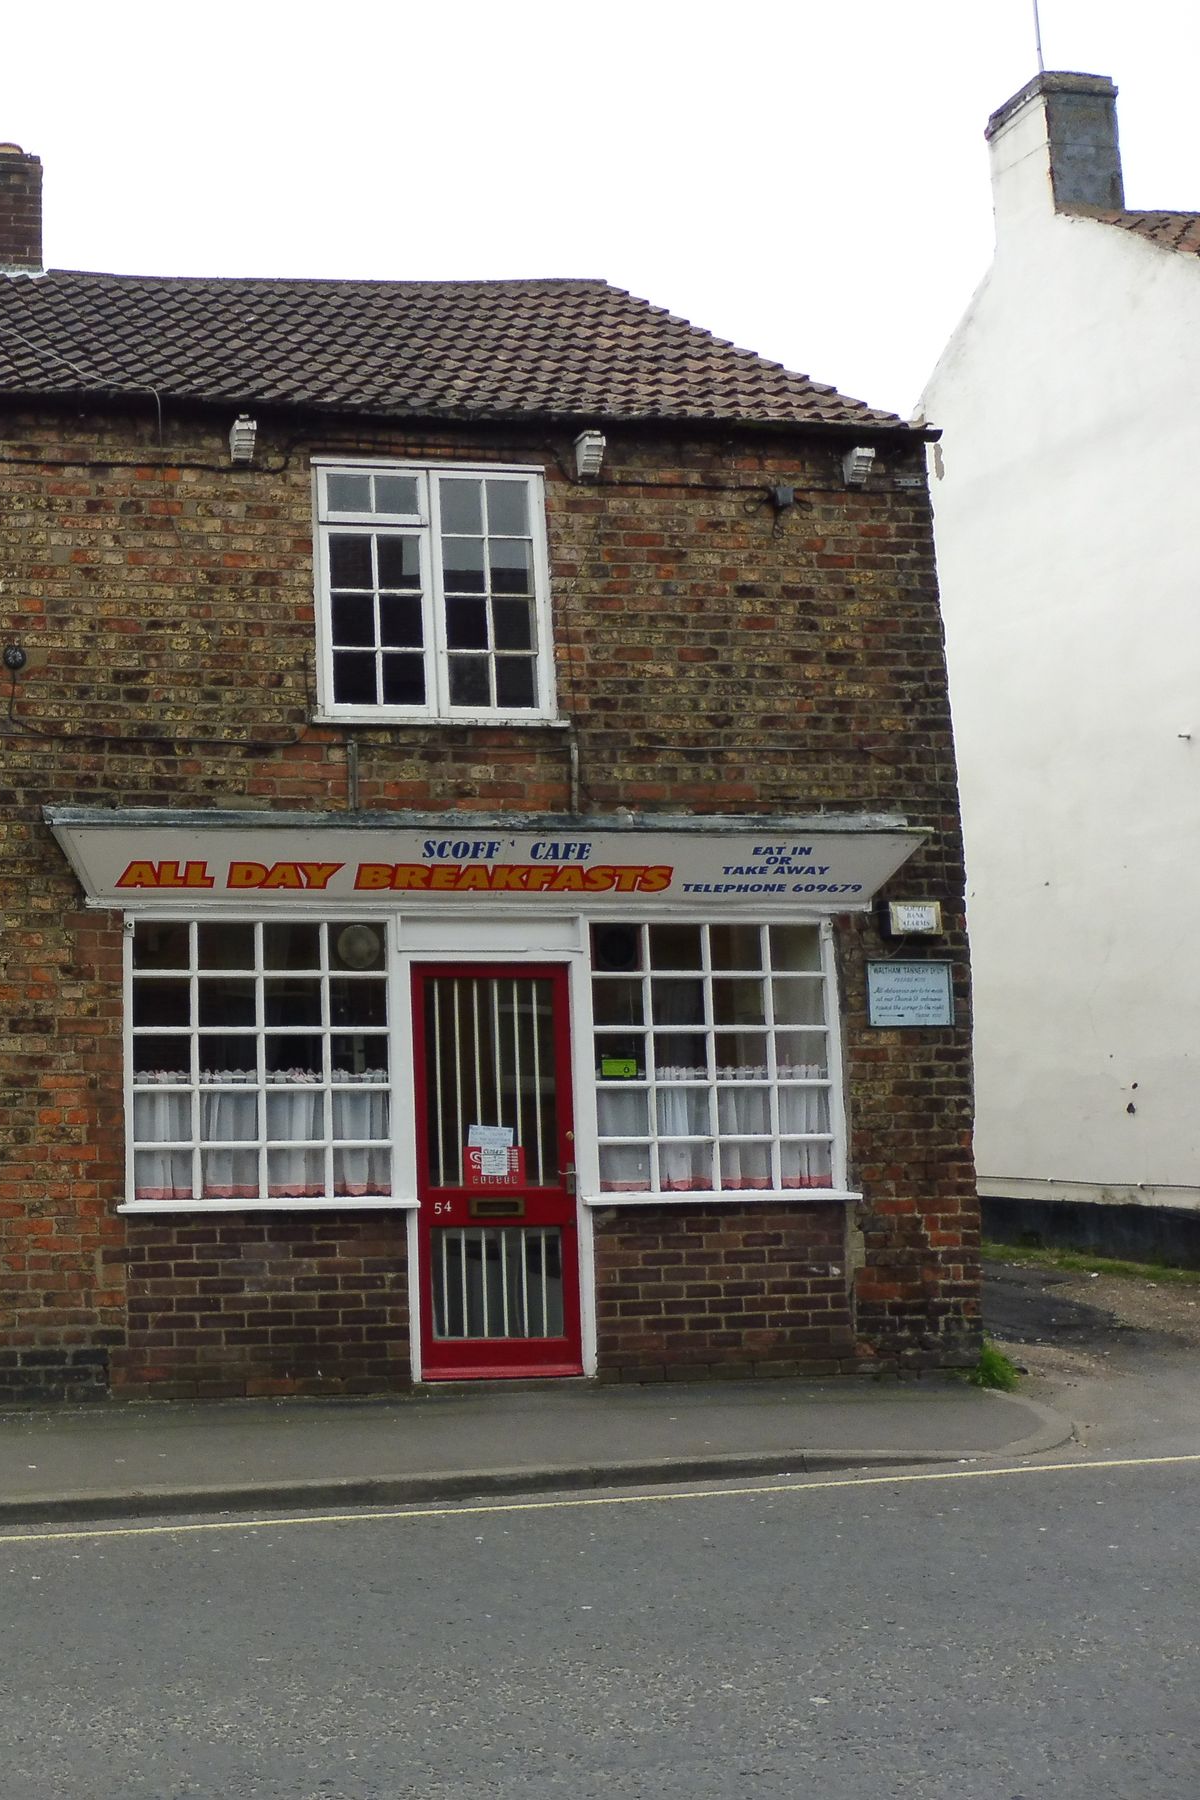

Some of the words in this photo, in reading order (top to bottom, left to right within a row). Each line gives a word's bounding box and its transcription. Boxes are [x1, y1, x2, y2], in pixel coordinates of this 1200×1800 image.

[530, 842, 592, 861] CAFE
[752, 846, 787, 856] EAT
[791, 846, 813, 856] IN
[765, 856, 793, 865] OR
[722, 866, 768, 875] TAKE
[773, 866, 830, 875] AWAY
[114, 861, 215, 888] ALL
[226, 861, 346, 890] DAY
[353, 863, 674, 893] BREAKFASTS
[682, 883, 787, 893] TELEPHONE
[792, 883, 863, 893] 609679
[434, 1200, 452, 1215] 54
